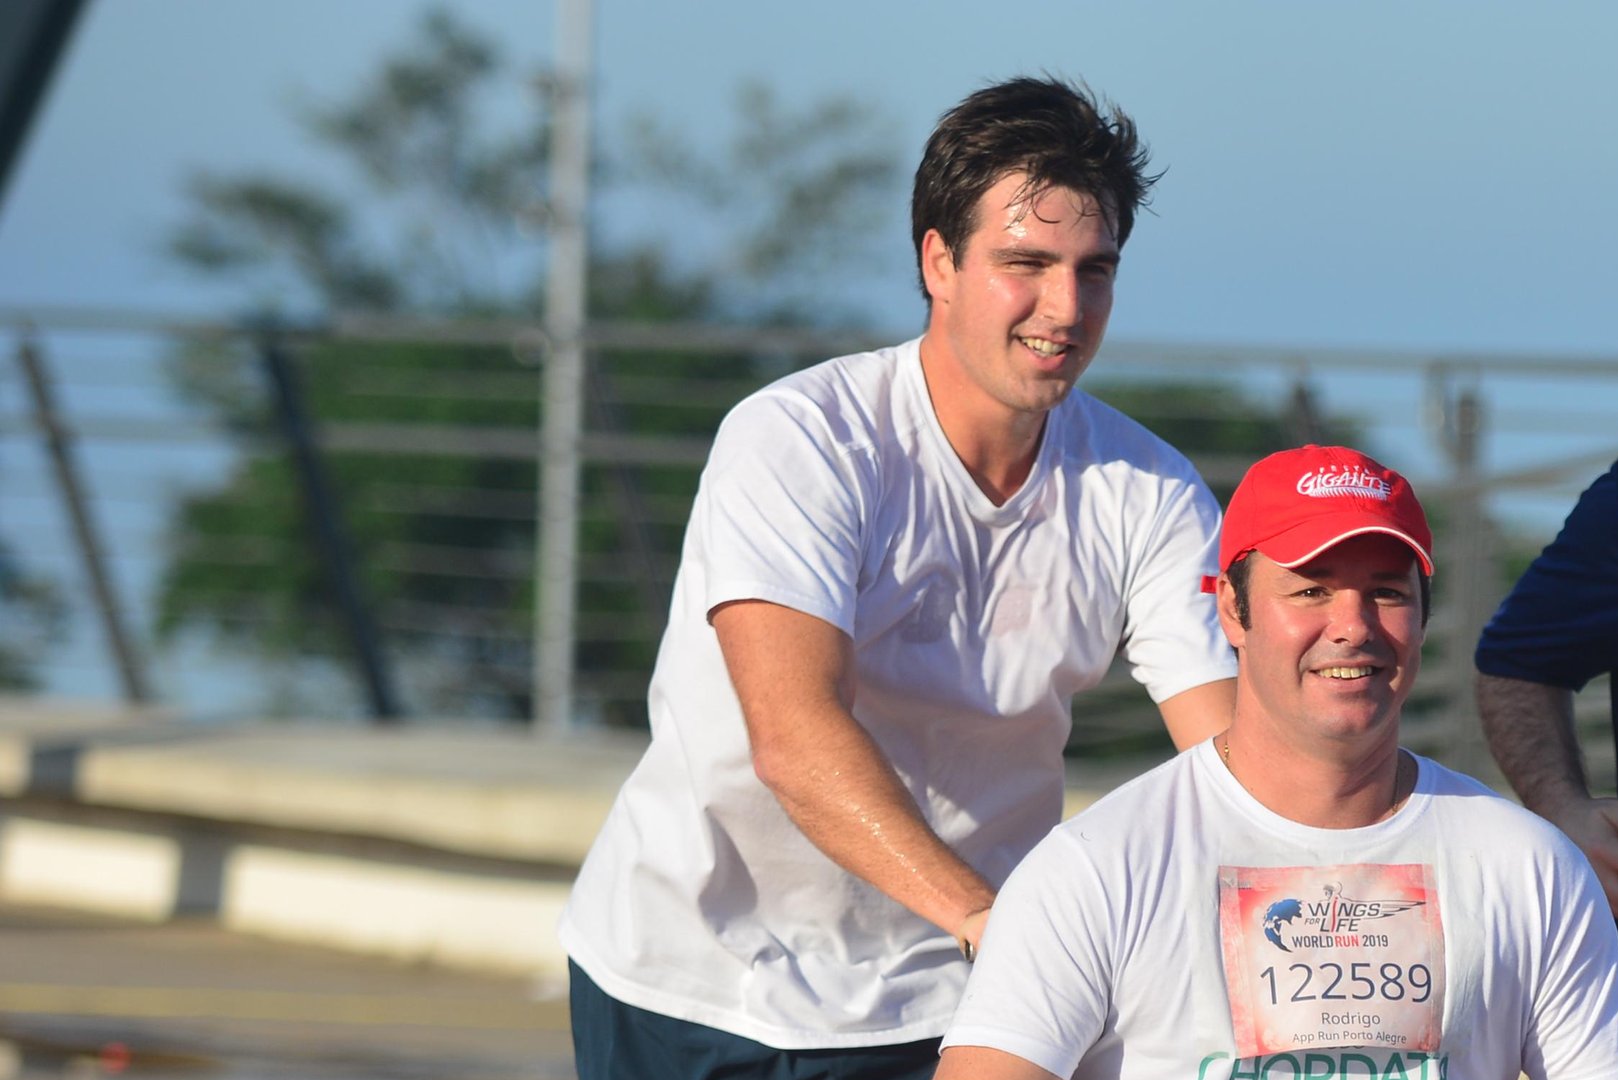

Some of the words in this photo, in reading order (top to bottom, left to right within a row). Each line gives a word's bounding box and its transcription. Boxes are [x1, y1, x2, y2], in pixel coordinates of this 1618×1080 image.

[1308, 899, 1381, 917] WINGS
[1304, 917, 1321, 926] FOR
[1319, 917, 1362, 933] LIFE
[1292, 935, 1334, 948] WORLD
[1334, 934, 1359, 947] RUN
[1362, 934, 1389, 948] 2019
[1259, 962, 1433, 1005] 122589
[1321, 1012, 1381, 1028] Rodrigo
[1293, 1033, 1315, 1045] App
[1318, 1031, 1341, 1041] Run
[1343, 1030, 1373, 1041] Porto
[1375, 1031, 1408, 1046] Alegre
